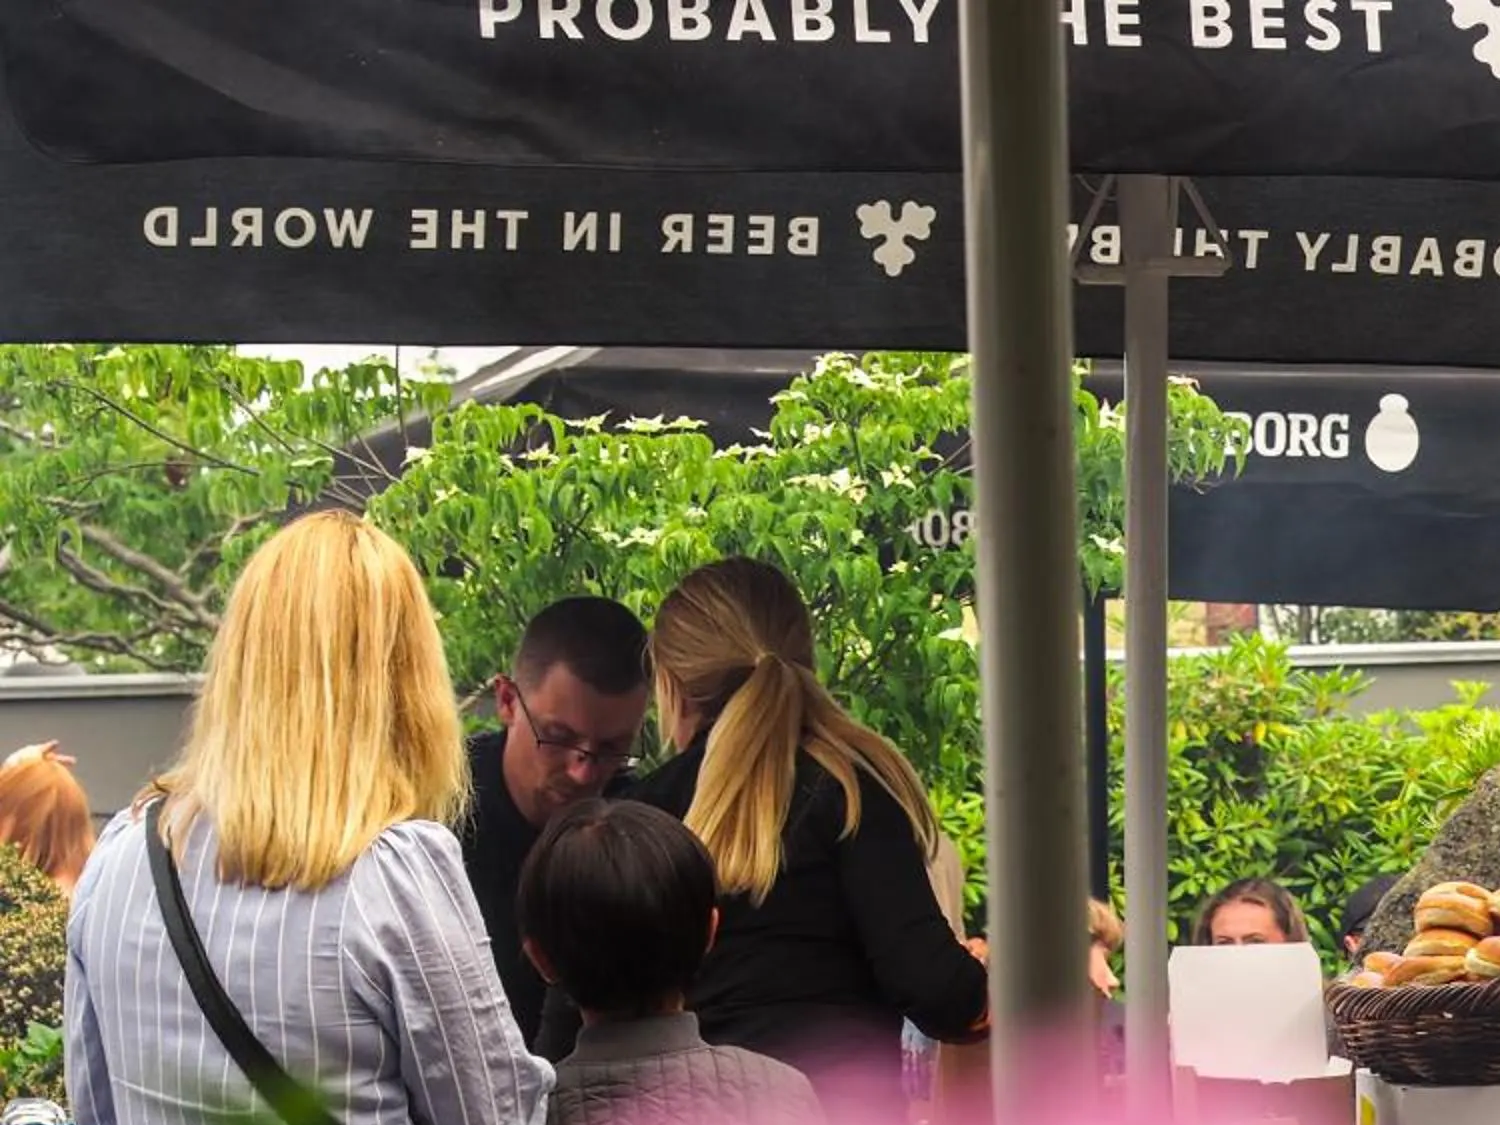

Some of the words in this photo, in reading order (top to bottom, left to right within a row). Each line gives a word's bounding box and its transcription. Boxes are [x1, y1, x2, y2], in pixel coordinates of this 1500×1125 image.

[479, 0, 939, 43] PROBABLY
[1060, 0, 1142, 47] HE
[1189, 0, 1393, 53] BEST
[1222, 411, 1349, 458] BORG
